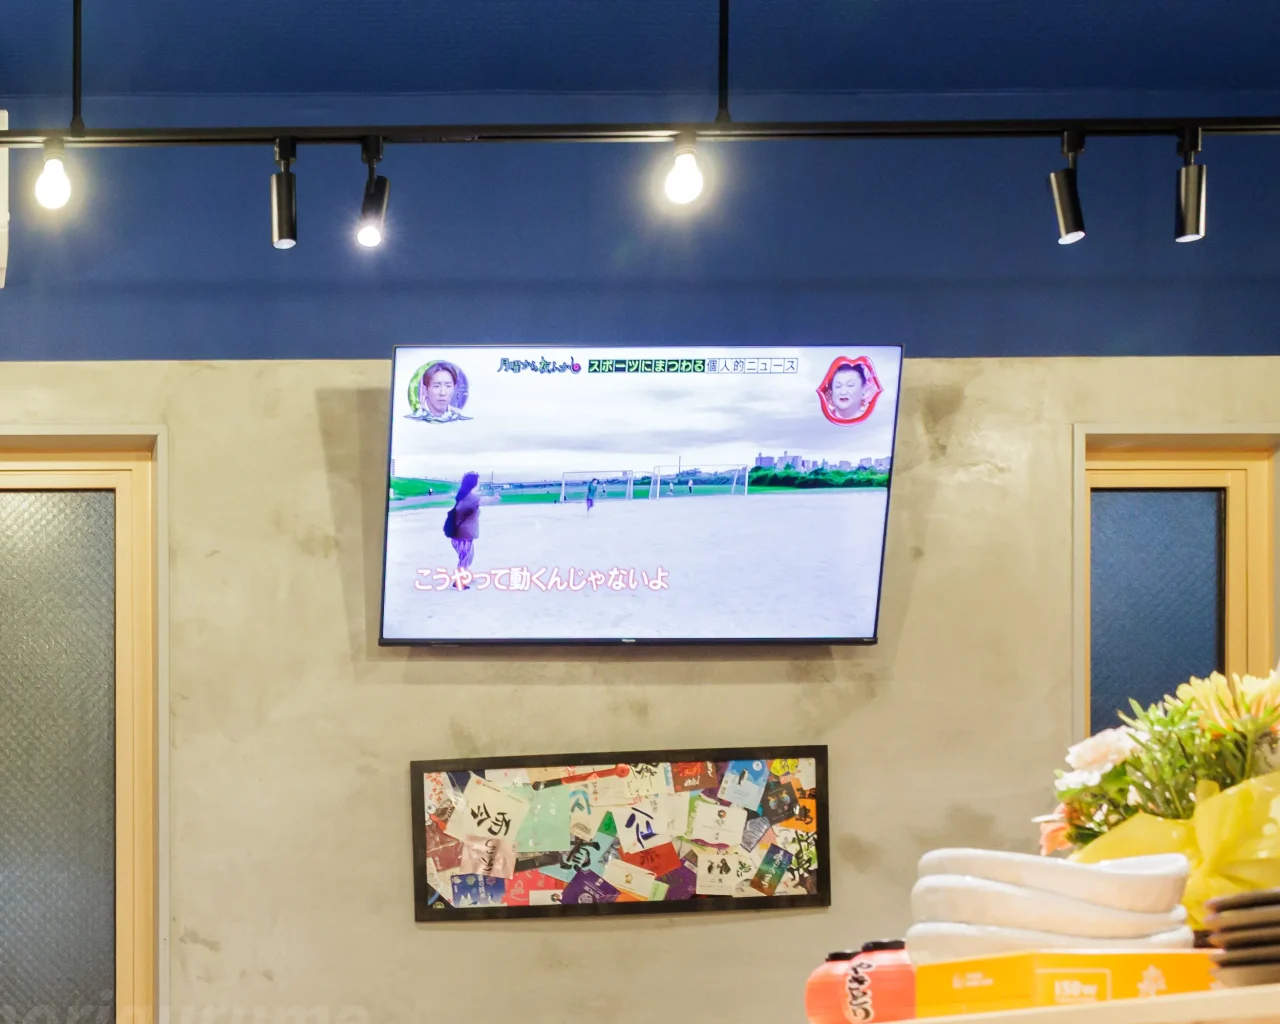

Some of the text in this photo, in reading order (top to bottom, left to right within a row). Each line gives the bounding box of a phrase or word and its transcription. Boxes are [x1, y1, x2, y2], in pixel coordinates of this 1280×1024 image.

[413, 566, 670, 591] こうやって動くんじゃないよ
